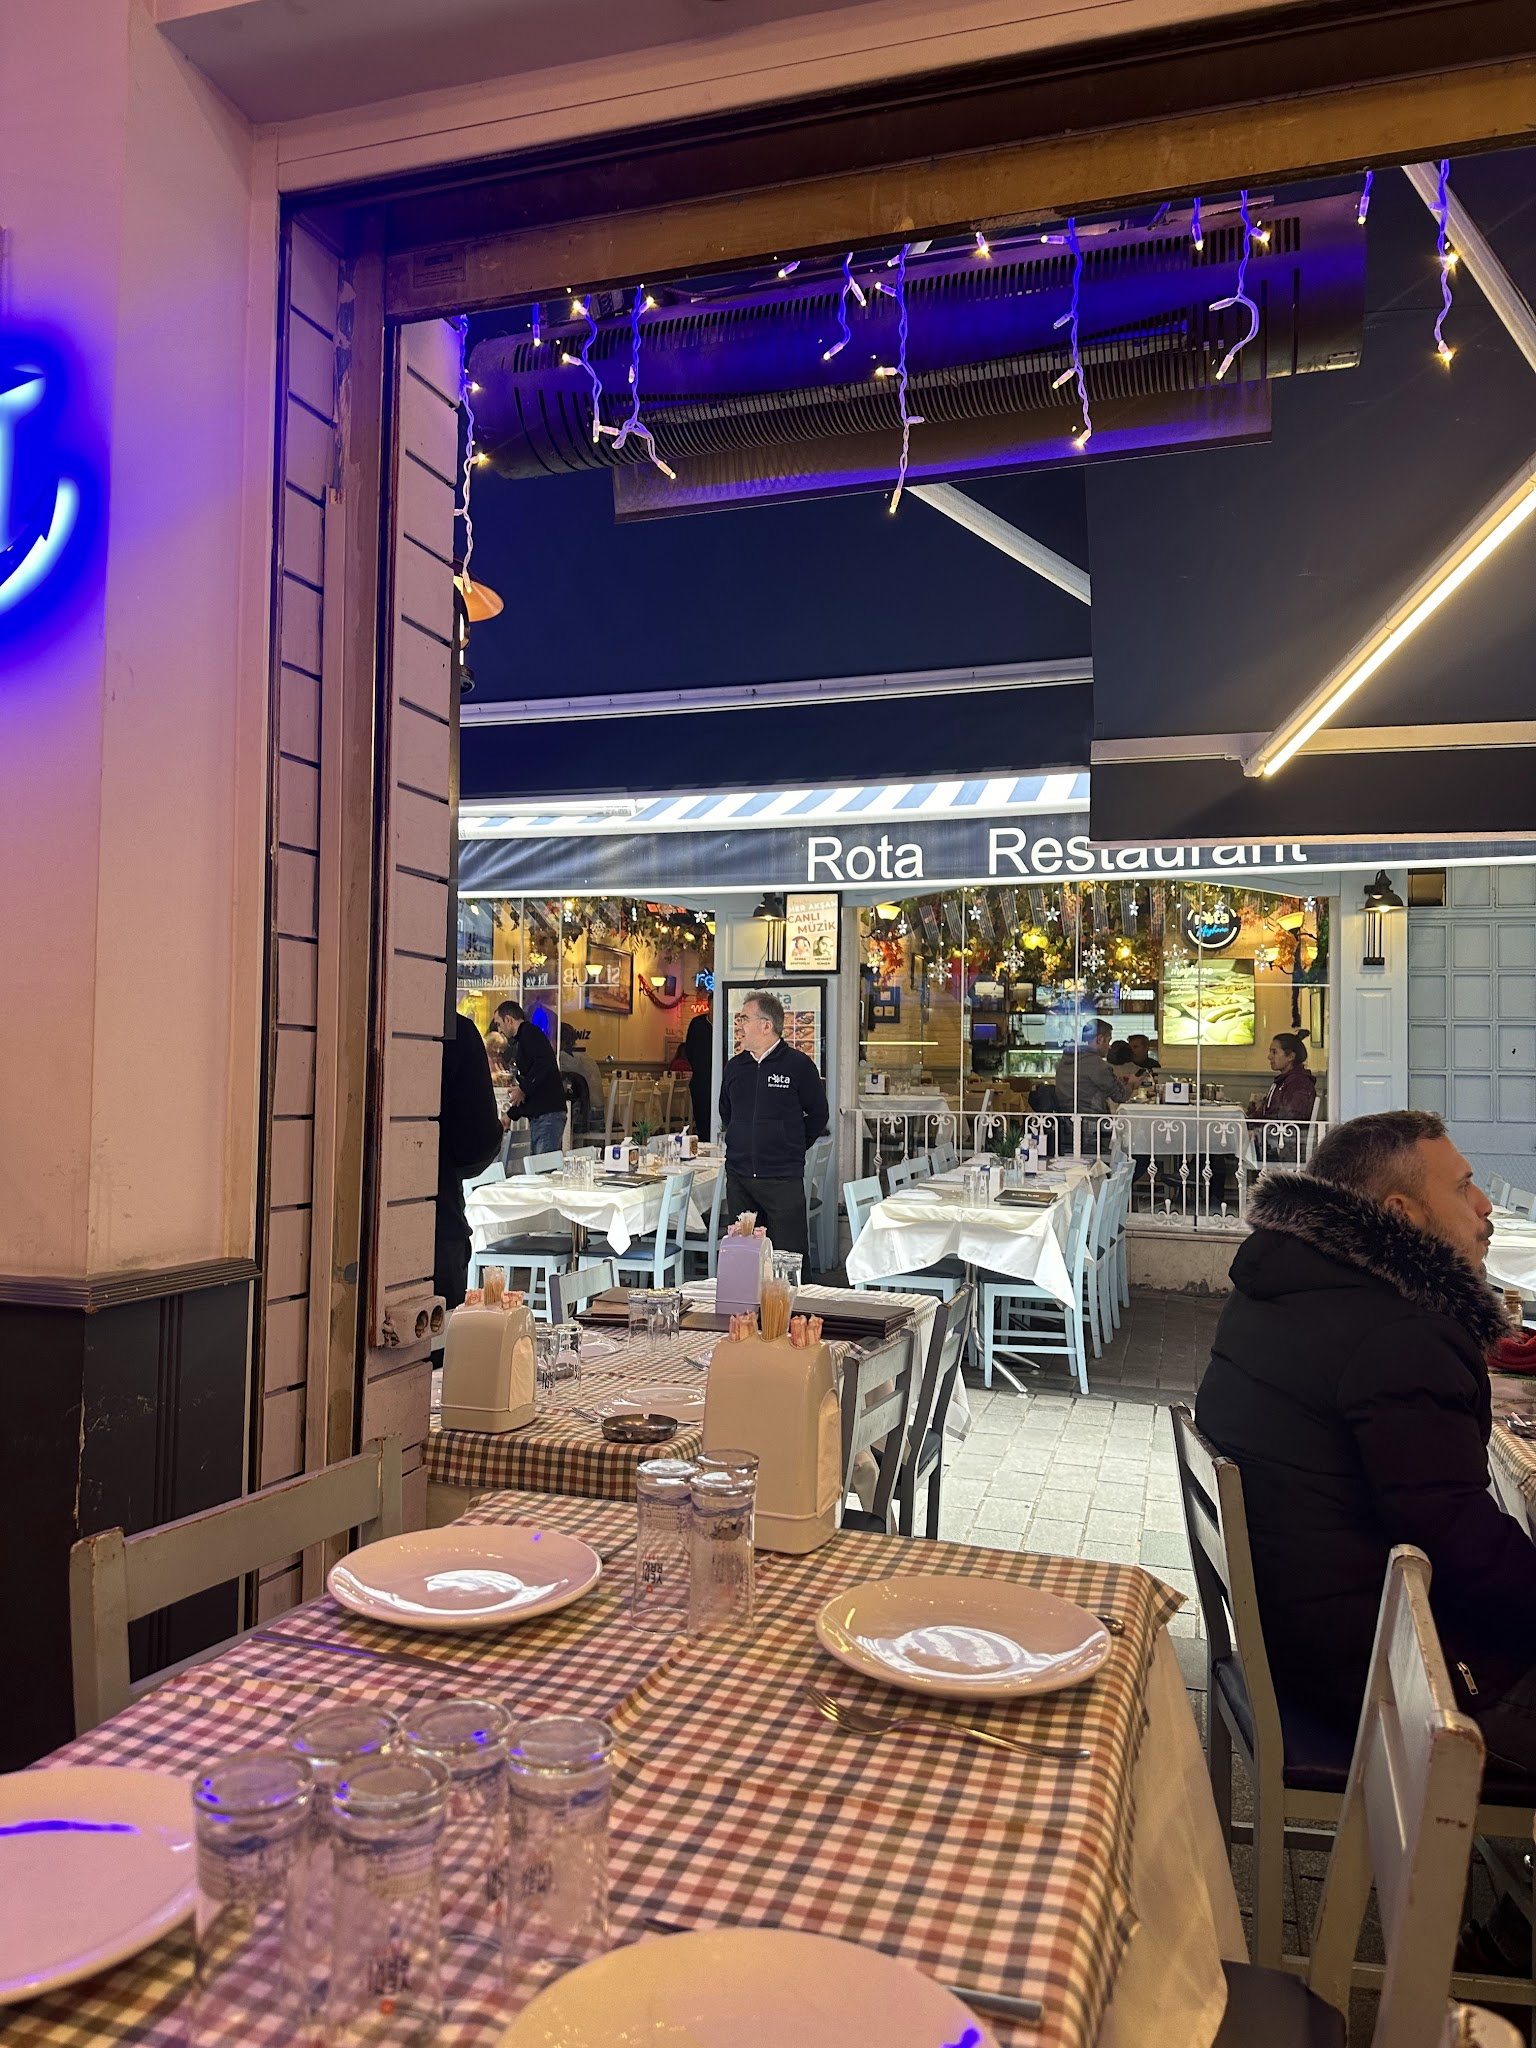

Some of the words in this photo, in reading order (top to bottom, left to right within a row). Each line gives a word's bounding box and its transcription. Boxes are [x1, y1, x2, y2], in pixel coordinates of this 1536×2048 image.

[807, 835, 924, 883] Rota
[787, 912, 820, 924] CANLI
[797, 919, 837, 934] MÜZİK
